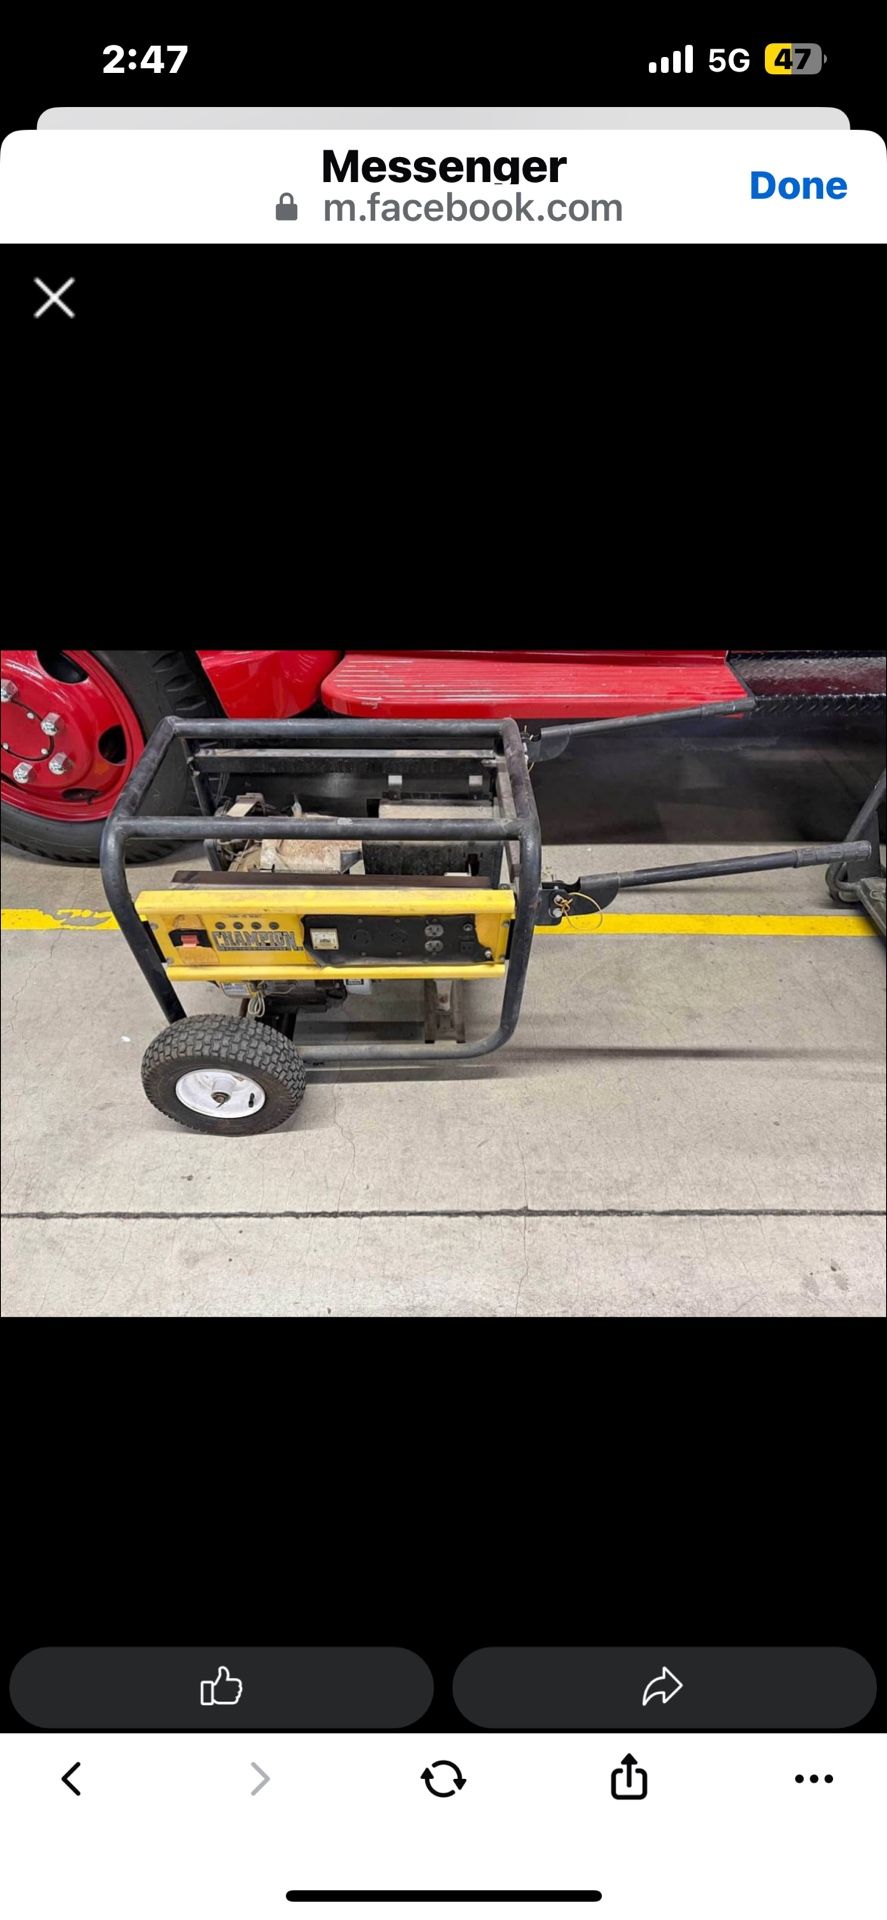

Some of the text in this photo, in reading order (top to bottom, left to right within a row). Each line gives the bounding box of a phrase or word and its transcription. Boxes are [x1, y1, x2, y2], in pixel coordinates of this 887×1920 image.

[102, 45, 189, 73] 2:47
[708, 48, 751, 73] 5G
[773, 48, 812, 70] 47
[322, 149, 568, 185] Messenger
[750, 171, 849, 200] Done
[324, 192, 623, 222] m.facebook.com
[212, 931, 297, 951] CHAMPION
